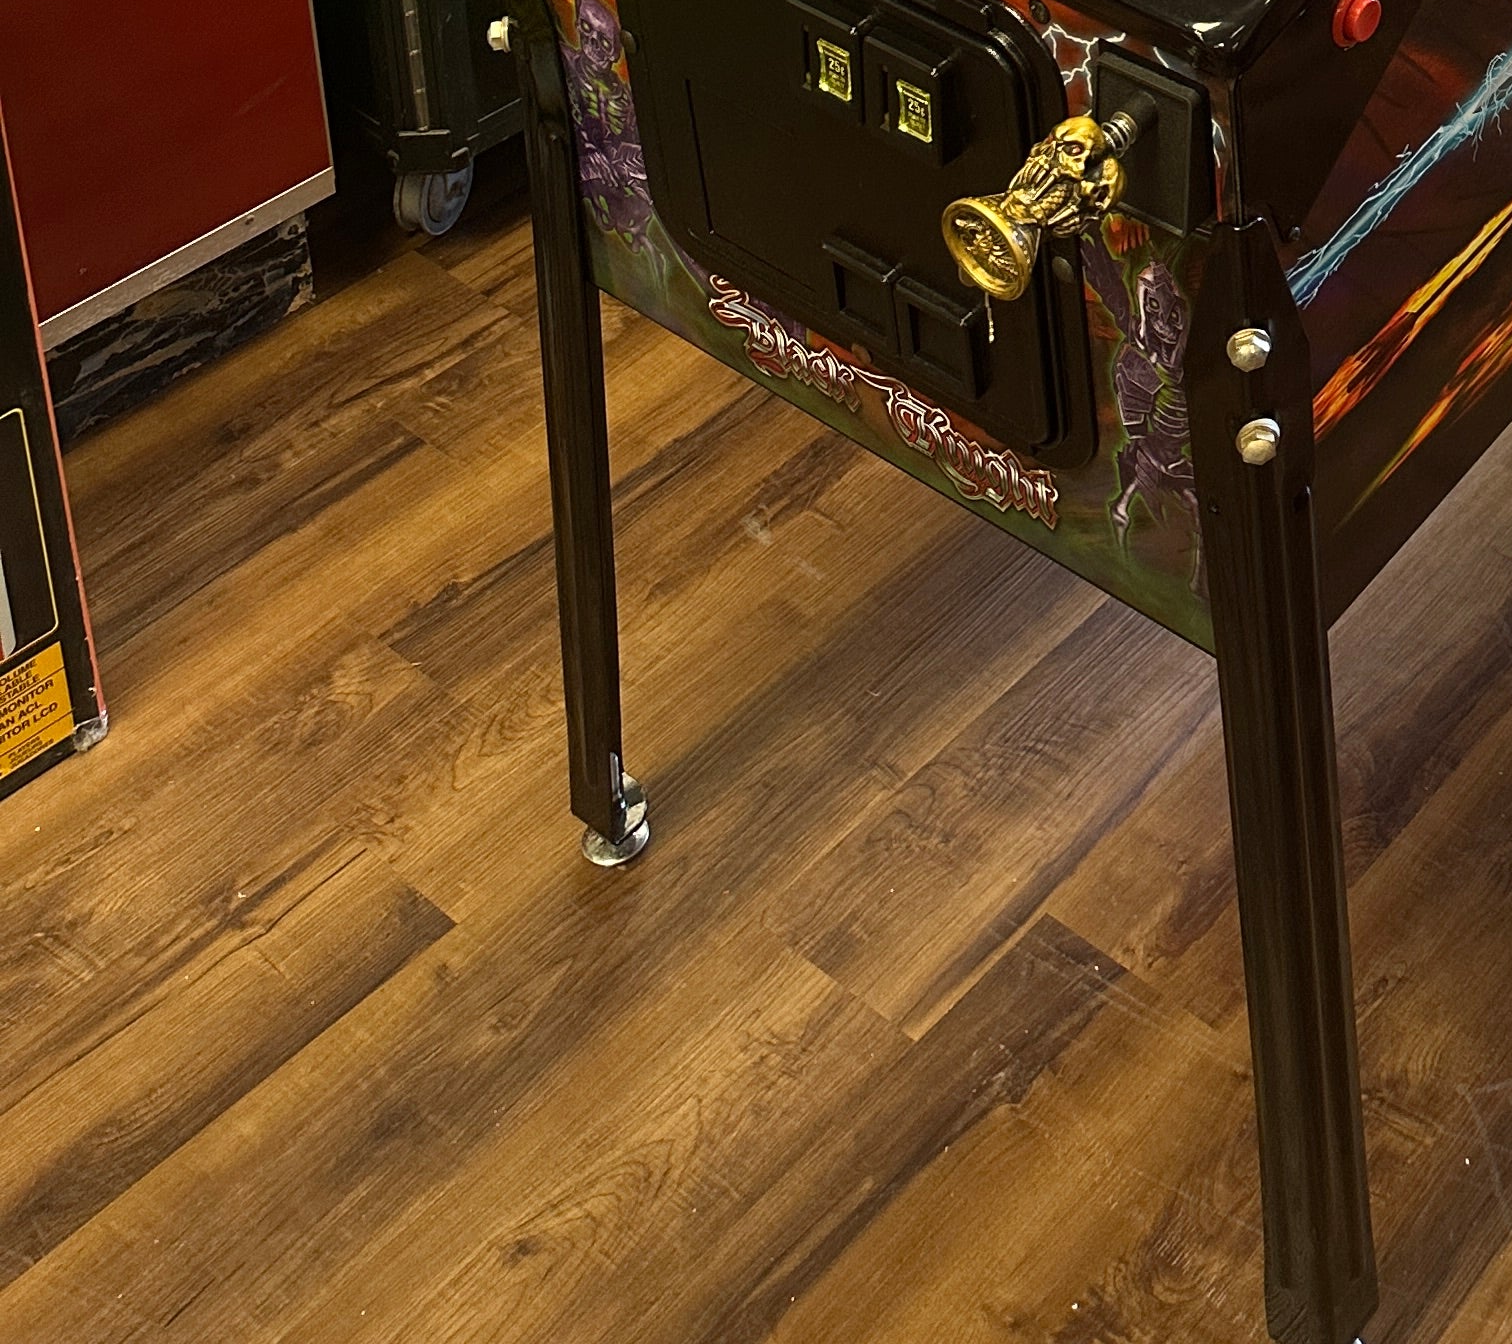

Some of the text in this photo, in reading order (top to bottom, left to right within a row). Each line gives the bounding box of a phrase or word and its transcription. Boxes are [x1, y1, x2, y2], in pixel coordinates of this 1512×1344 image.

[0, 658, 37, 687] OLUME
[0, 673, 41, 703] STABLE
[18, 700, 42, 719] ACL
[33, 701, 59, 723] LCD
